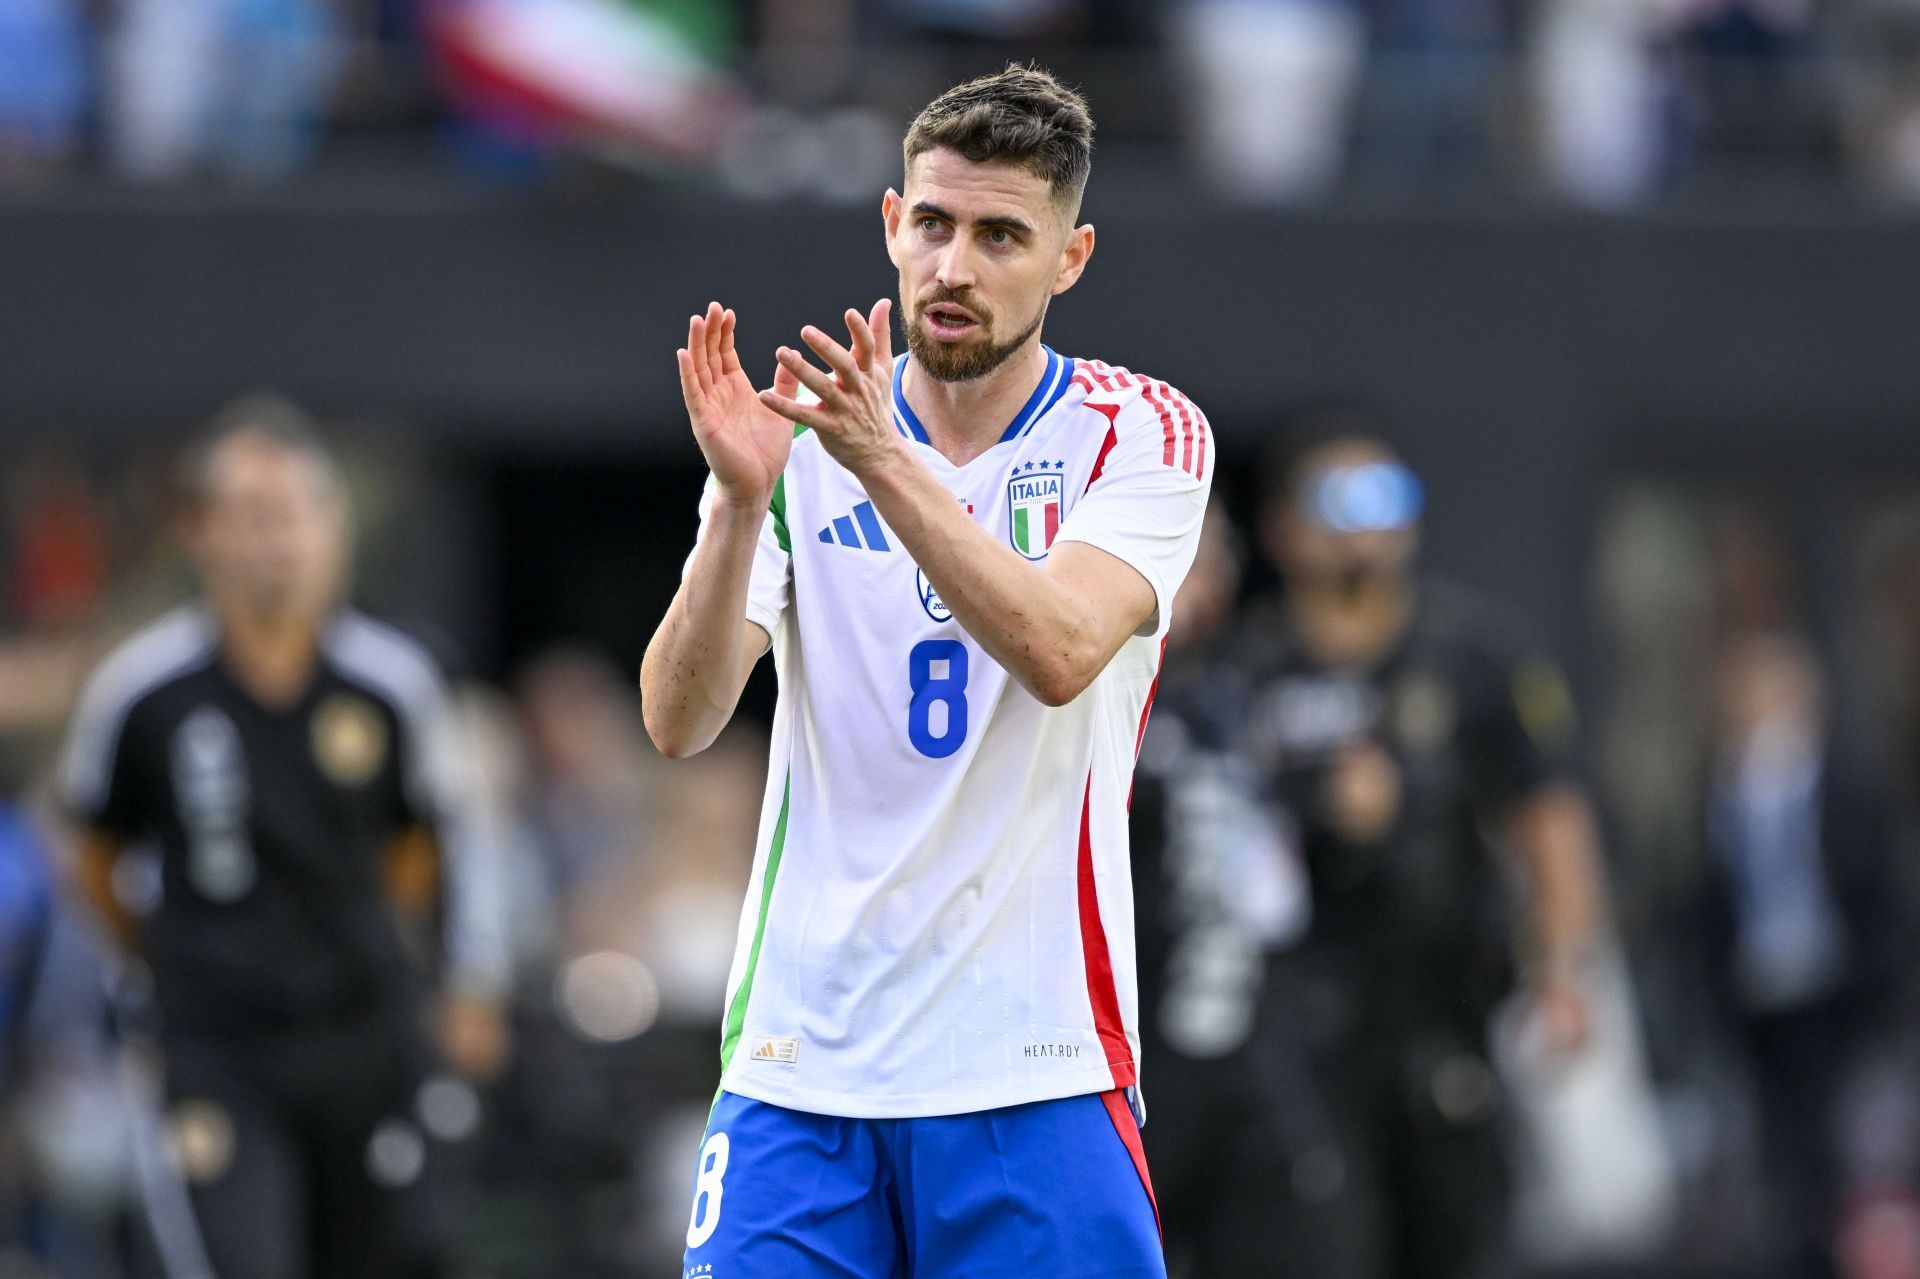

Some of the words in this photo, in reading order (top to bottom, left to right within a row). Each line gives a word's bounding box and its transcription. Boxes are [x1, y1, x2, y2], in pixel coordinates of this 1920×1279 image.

[1013, 480, 1058, 500] ITALIA
[909, 640, 968, 758] 8
[1024, 1045, 1080, 1057] HEAT.RDY
[686, 1132, 729, 1248] 8
